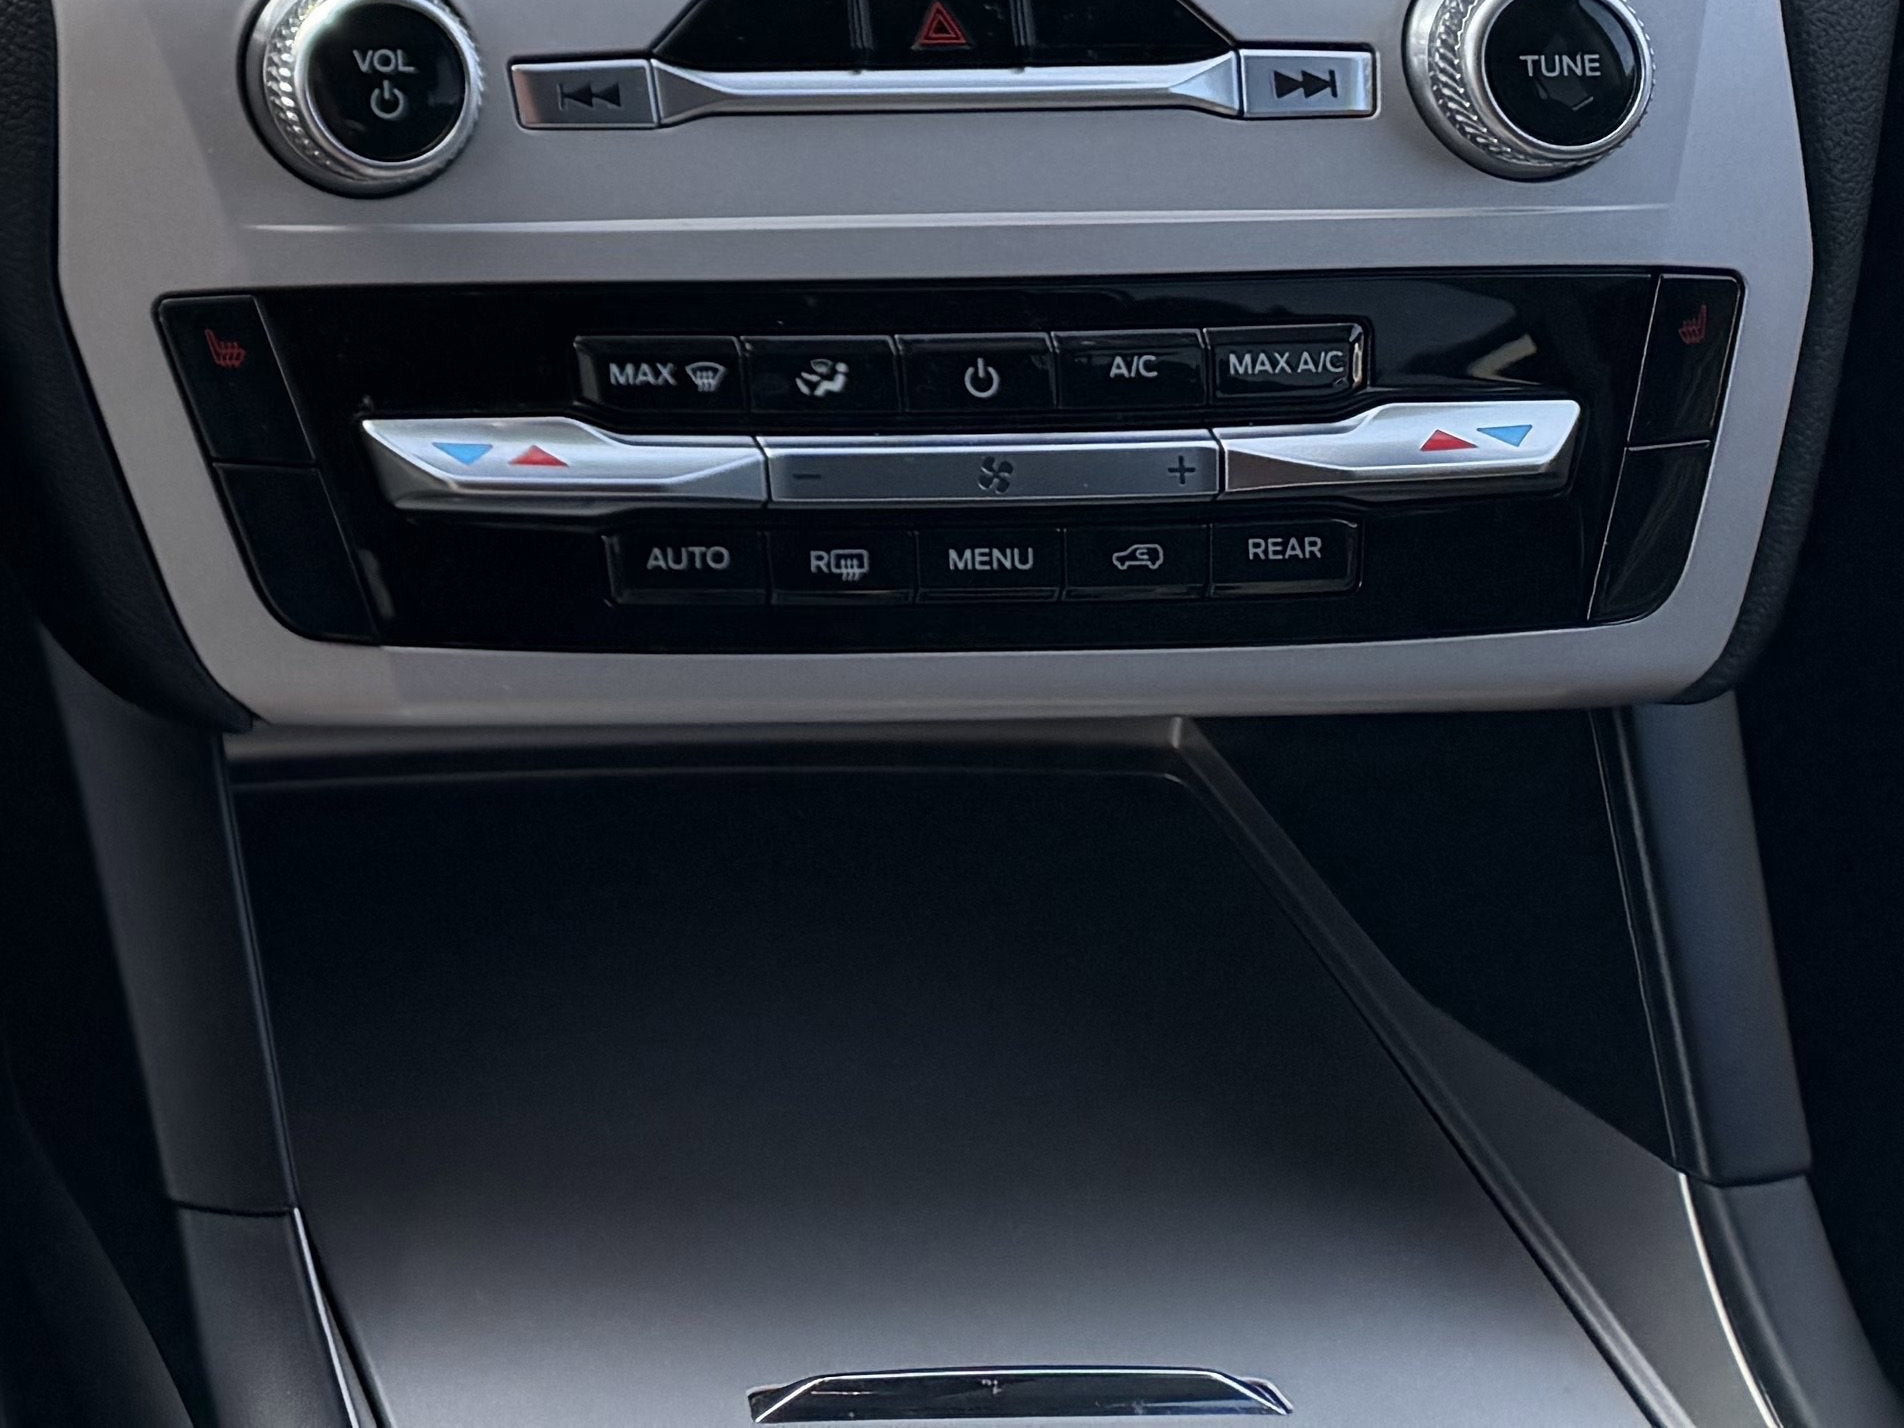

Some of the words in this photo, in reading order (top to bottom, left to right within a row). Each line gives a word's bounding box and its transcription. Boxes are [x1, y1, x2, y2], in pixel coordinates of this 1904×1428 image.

[352, 48, 416, 73] VOL
[1519, 53, 1601, 77] TUNE
[609, 363, 676, 387] MAX
[1109, 354, 1159, 379] A/C
[1228, 352, 1291, 376] MAX
[1296, 349, 1345, 375] A/C
[646, 545, 731, 572] AUTO
[948, 548, 1034, 572] MENU
[1247, 536, 1323, 562] REAR
[810, 550, 830, 574] R
